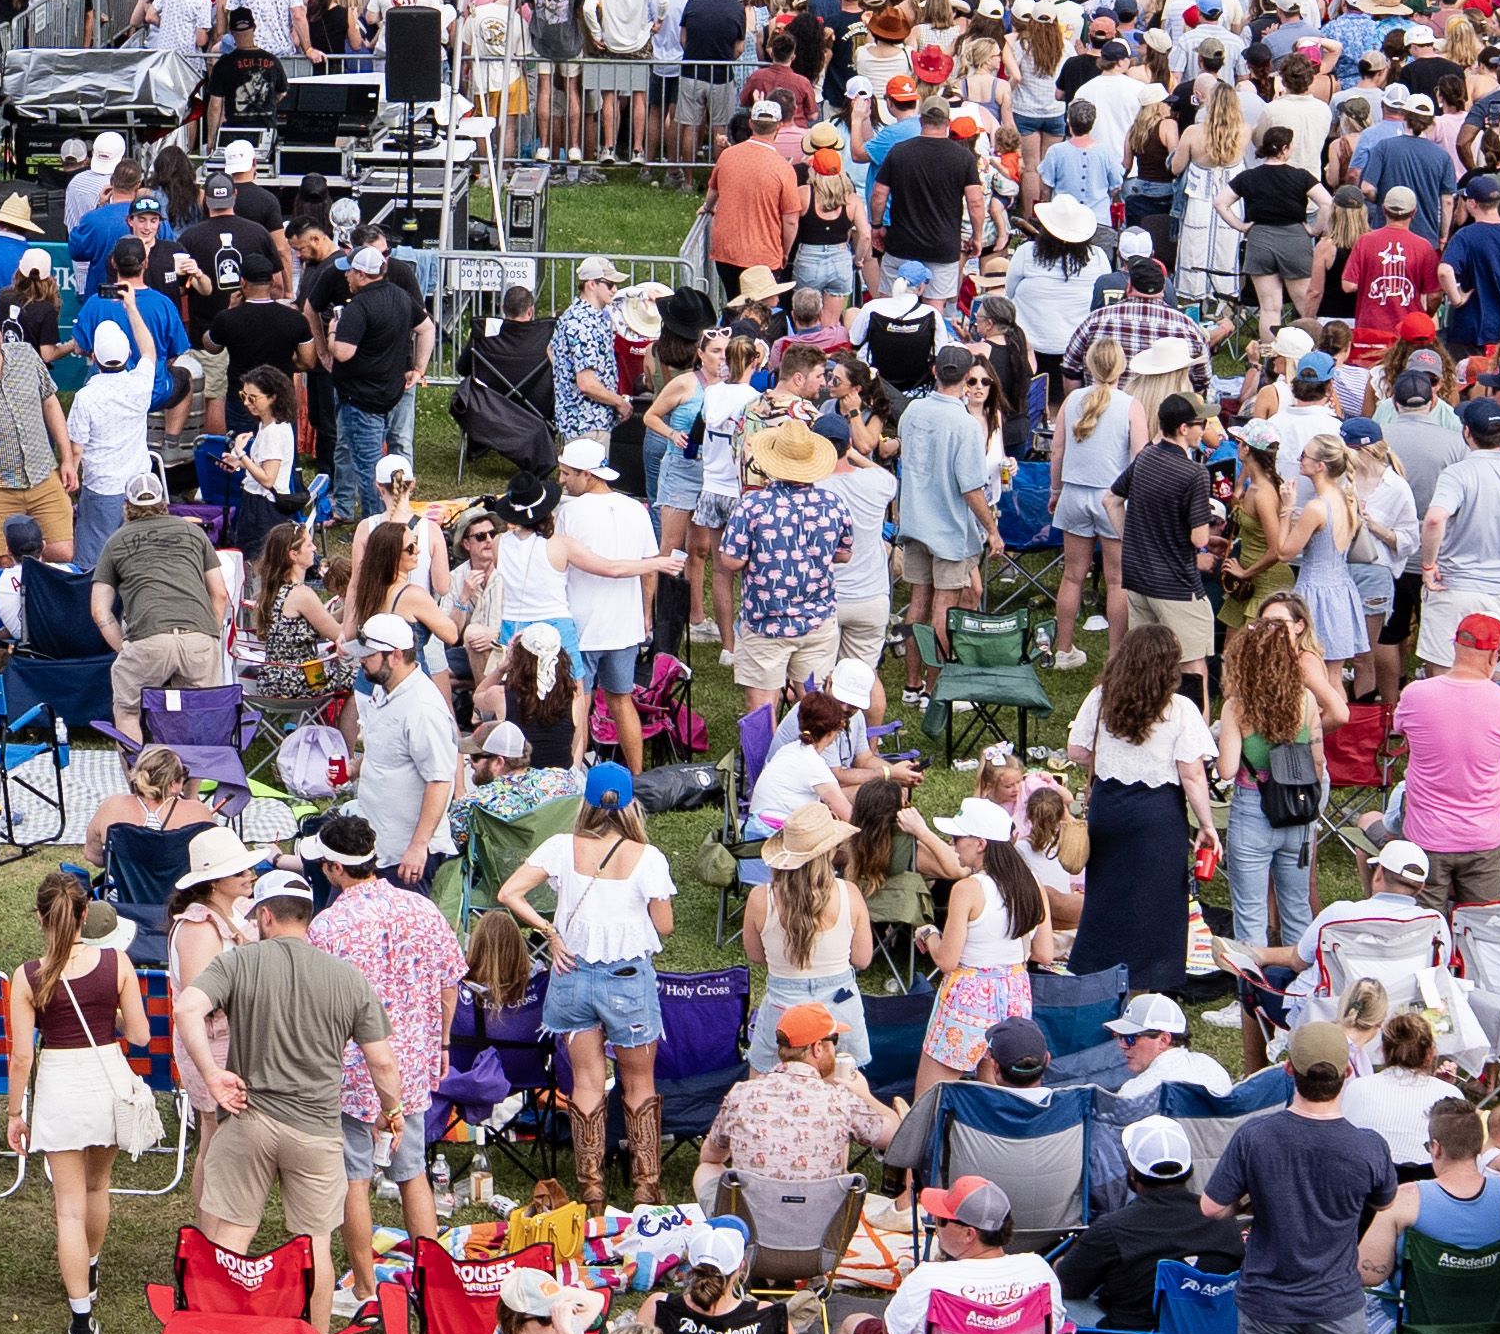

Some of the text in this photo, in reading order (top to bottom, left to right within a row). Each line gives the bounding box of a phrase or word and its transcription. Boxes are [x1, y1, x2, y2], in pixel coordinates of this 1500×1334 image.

[666, 984, 731, 999] Holy Cross
[215, 1248, 274, 1279] ROUSES
[1438, 1252, 1500, 1269] Academy
[452, 1260, 516, 1283] ROUSES
[966, 1308, 1023, 1328] Academy
